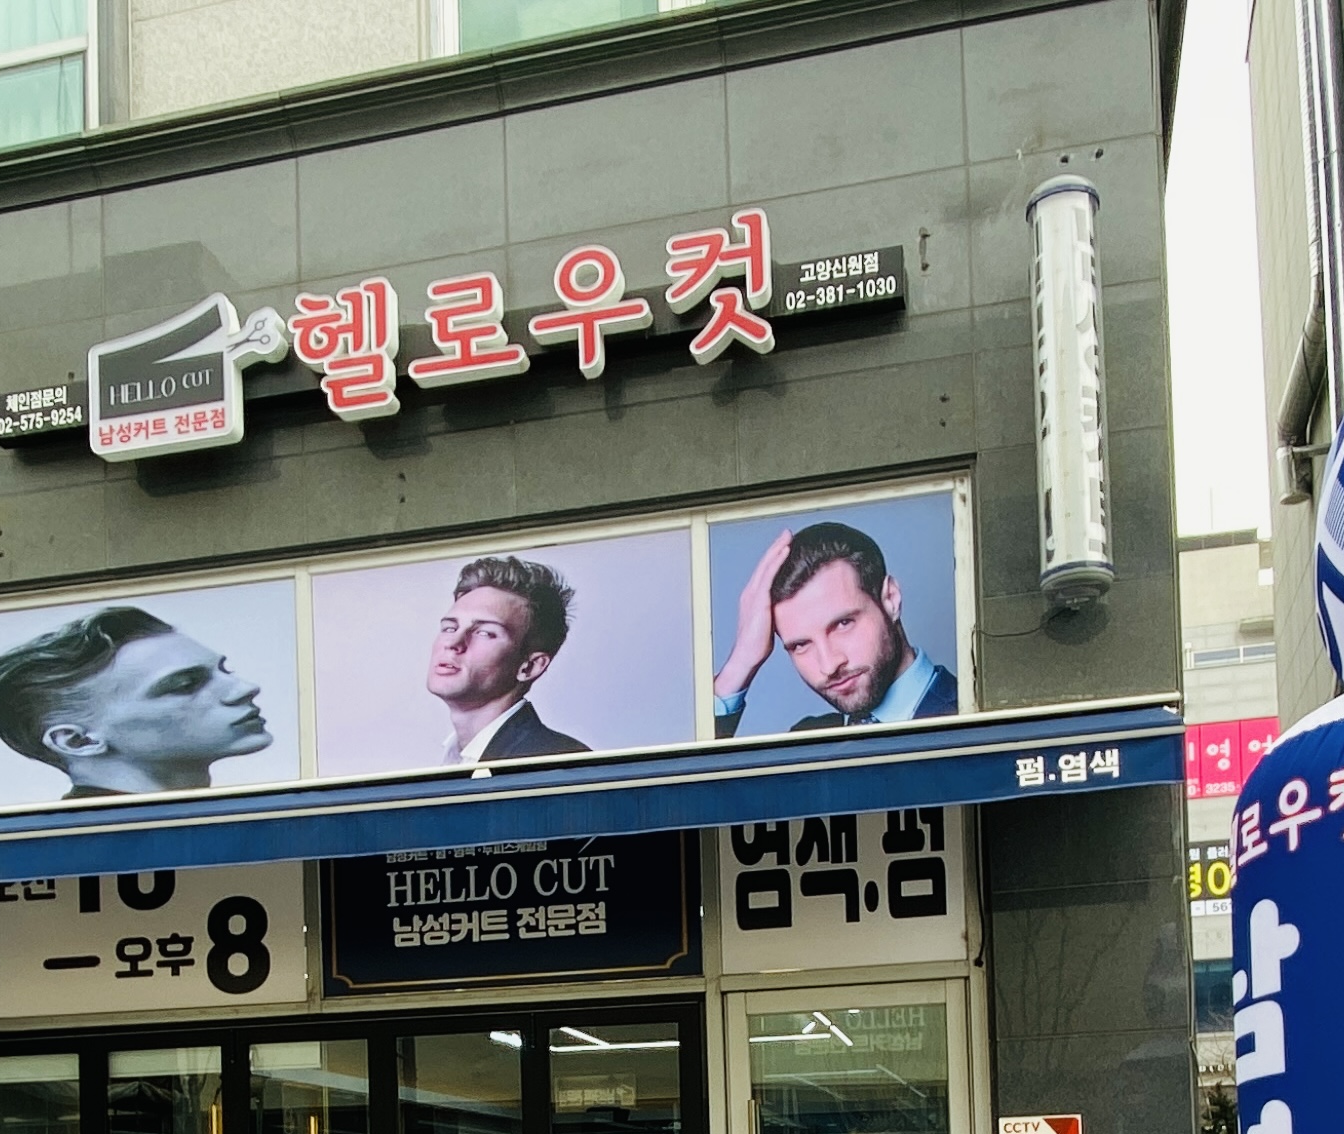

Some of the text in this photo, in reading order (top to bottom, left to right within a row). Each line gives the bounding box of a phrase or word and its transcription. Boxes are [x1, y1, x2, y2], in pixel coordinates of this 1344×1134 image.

[799, 251, 879, 282] 고양신원점
[786, 275, 896, 310] 02-381-1030
[290, 209, 775, 421] 헬로우컷
[6, 386, 67, 412] 체인점문의
[110, 368, 214, 405] HELLO CUT
[99, 408, 225, 446] 남성커트 전문점
[387, 855, 615, 907] HELLO CUT
[393, 902, 606, 947] 남성커트 전문점
[115, 896, 270, 994] 오후 8
[1003, 1122, 1040, 1133] CCTV
